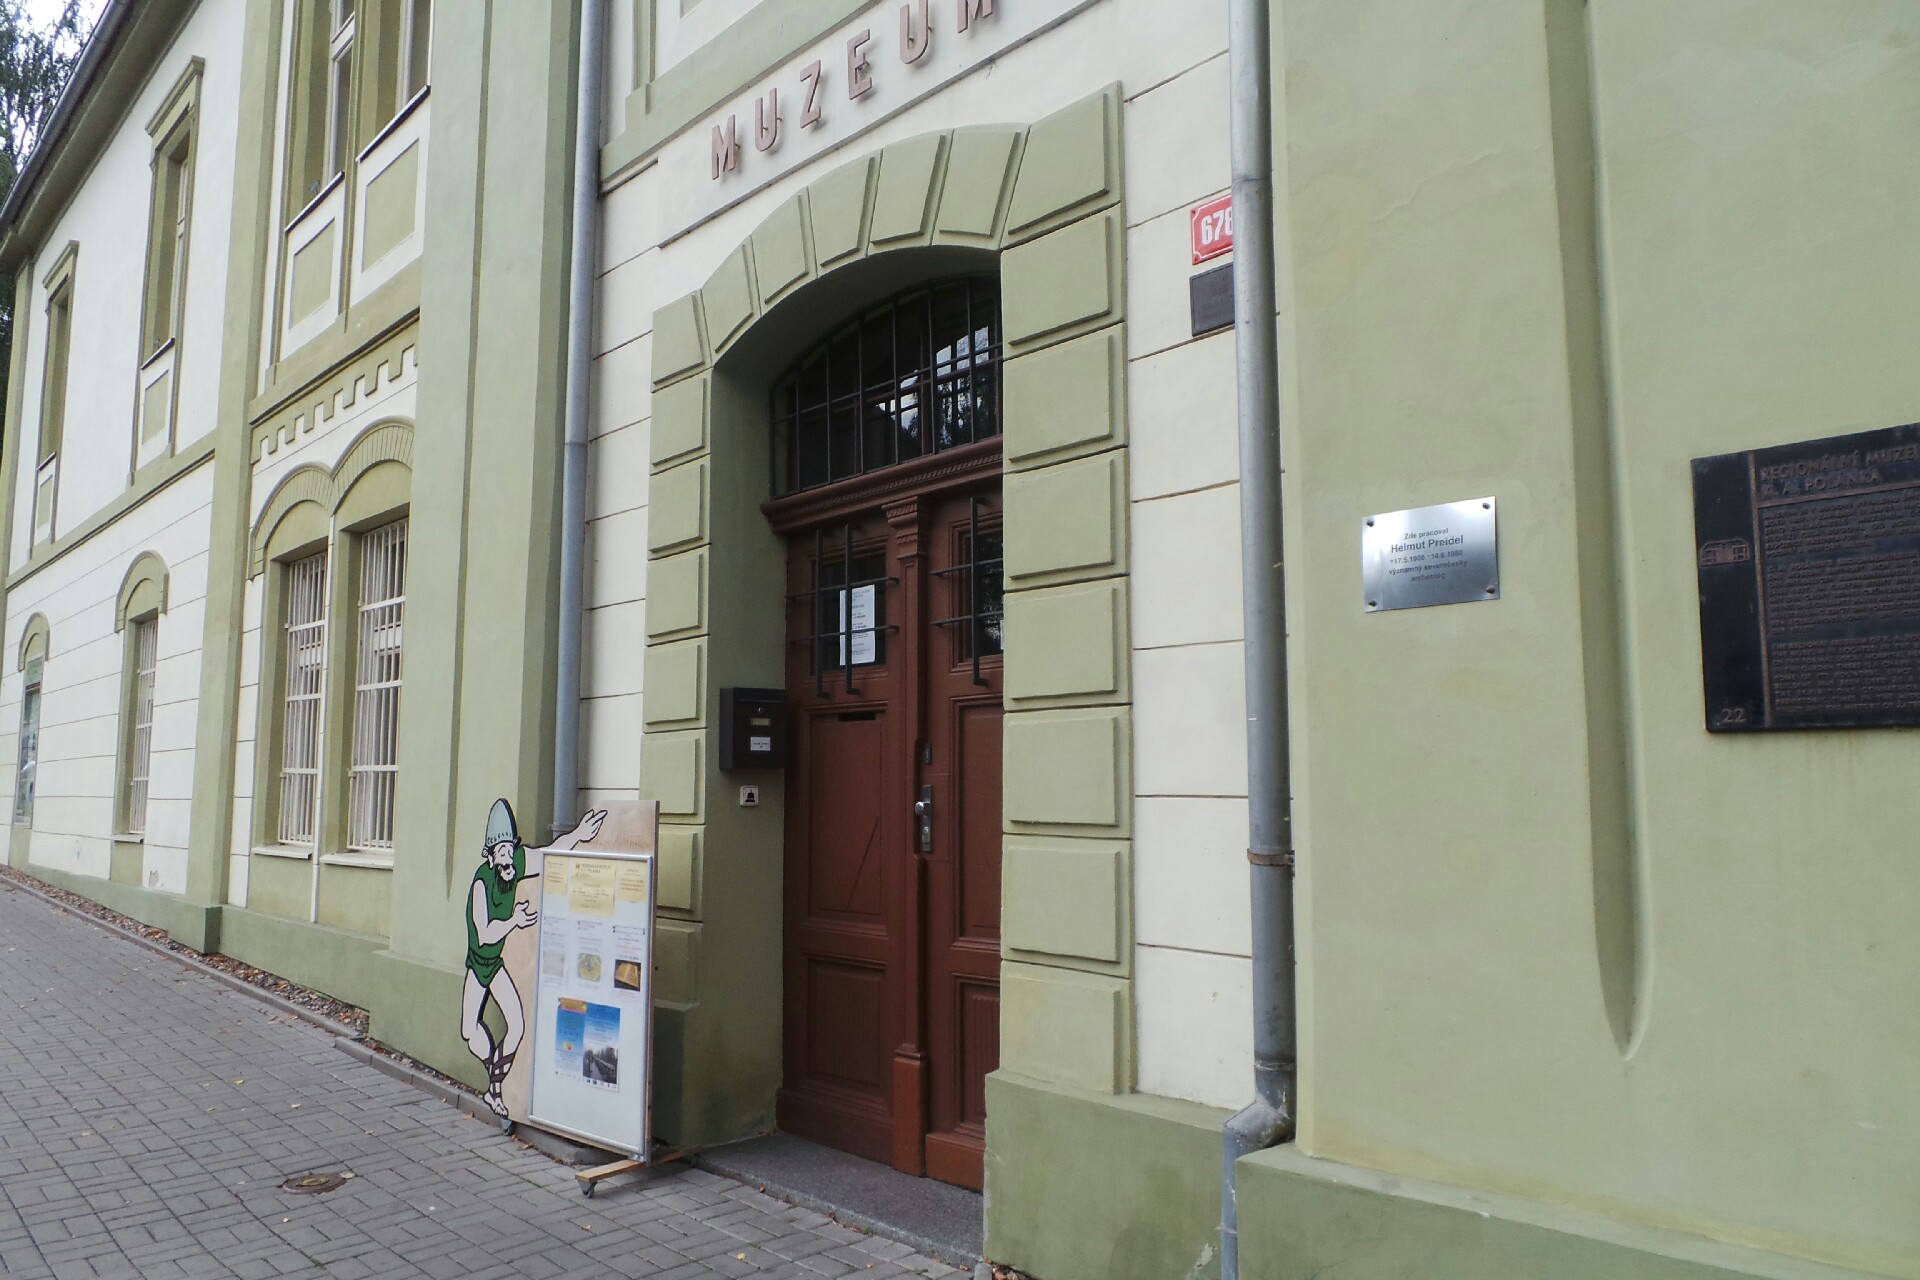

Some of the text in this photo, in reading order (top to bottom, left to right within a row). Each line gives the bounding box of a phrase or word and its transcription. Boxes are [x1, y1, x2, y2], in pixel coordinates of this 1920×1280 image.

[1404, 528, 1449, 540] Zde pracoval
[1391, 534, 1464, 554] Helmut Preidel
[1721, 708, 1746, 724] 22
